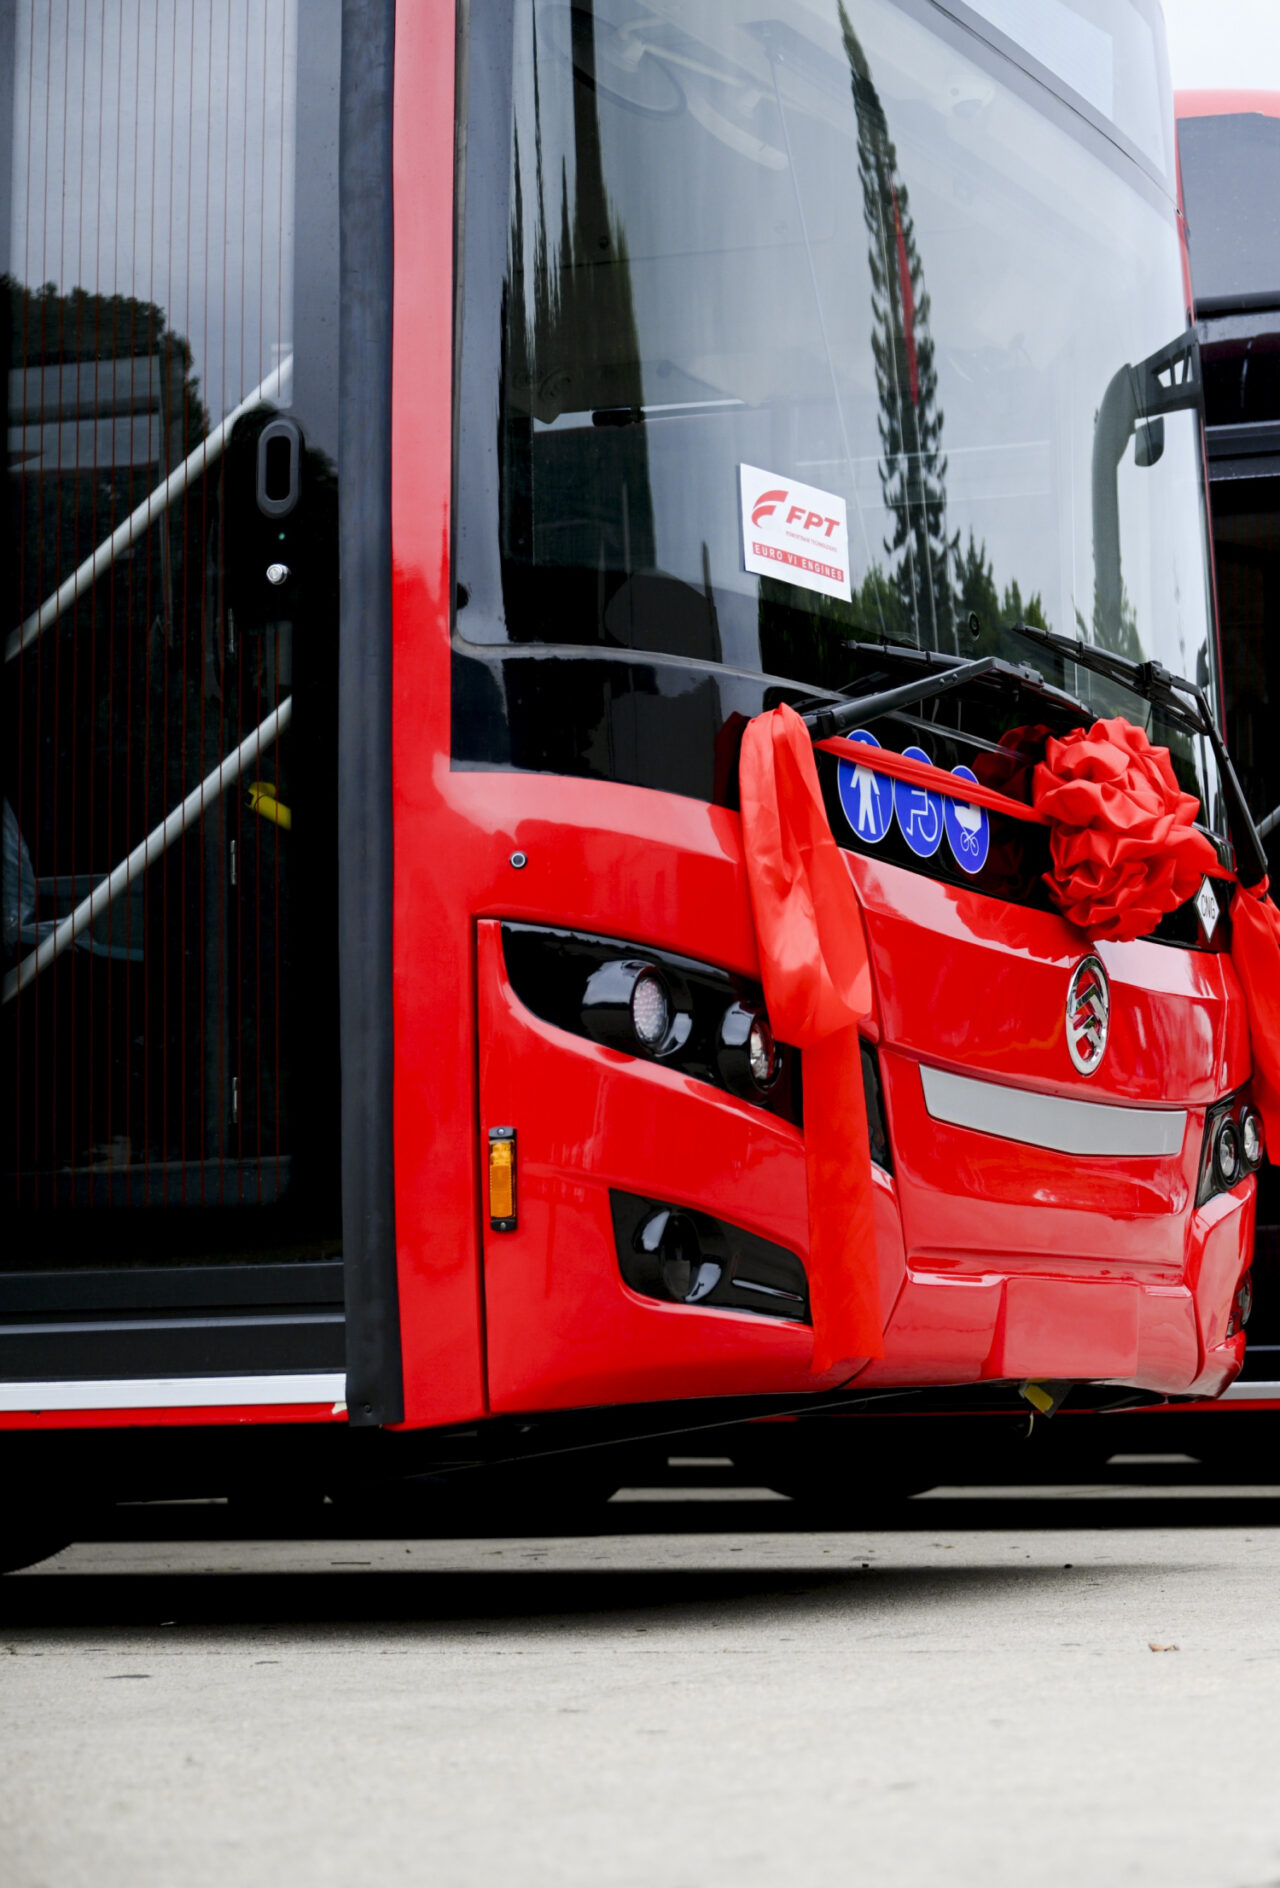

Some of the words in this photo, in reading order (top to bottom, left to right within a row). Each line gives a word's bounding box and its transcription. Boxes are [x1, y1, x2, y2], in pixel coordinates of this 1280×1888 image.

[786, 506, 840, 537] FPT
[755, 543, 783, 560] EURO
[787, 553, 797, 566] VI
[801, 558, 842, 580] ENGINES
[1200, 894, 1215, 919] CNG
